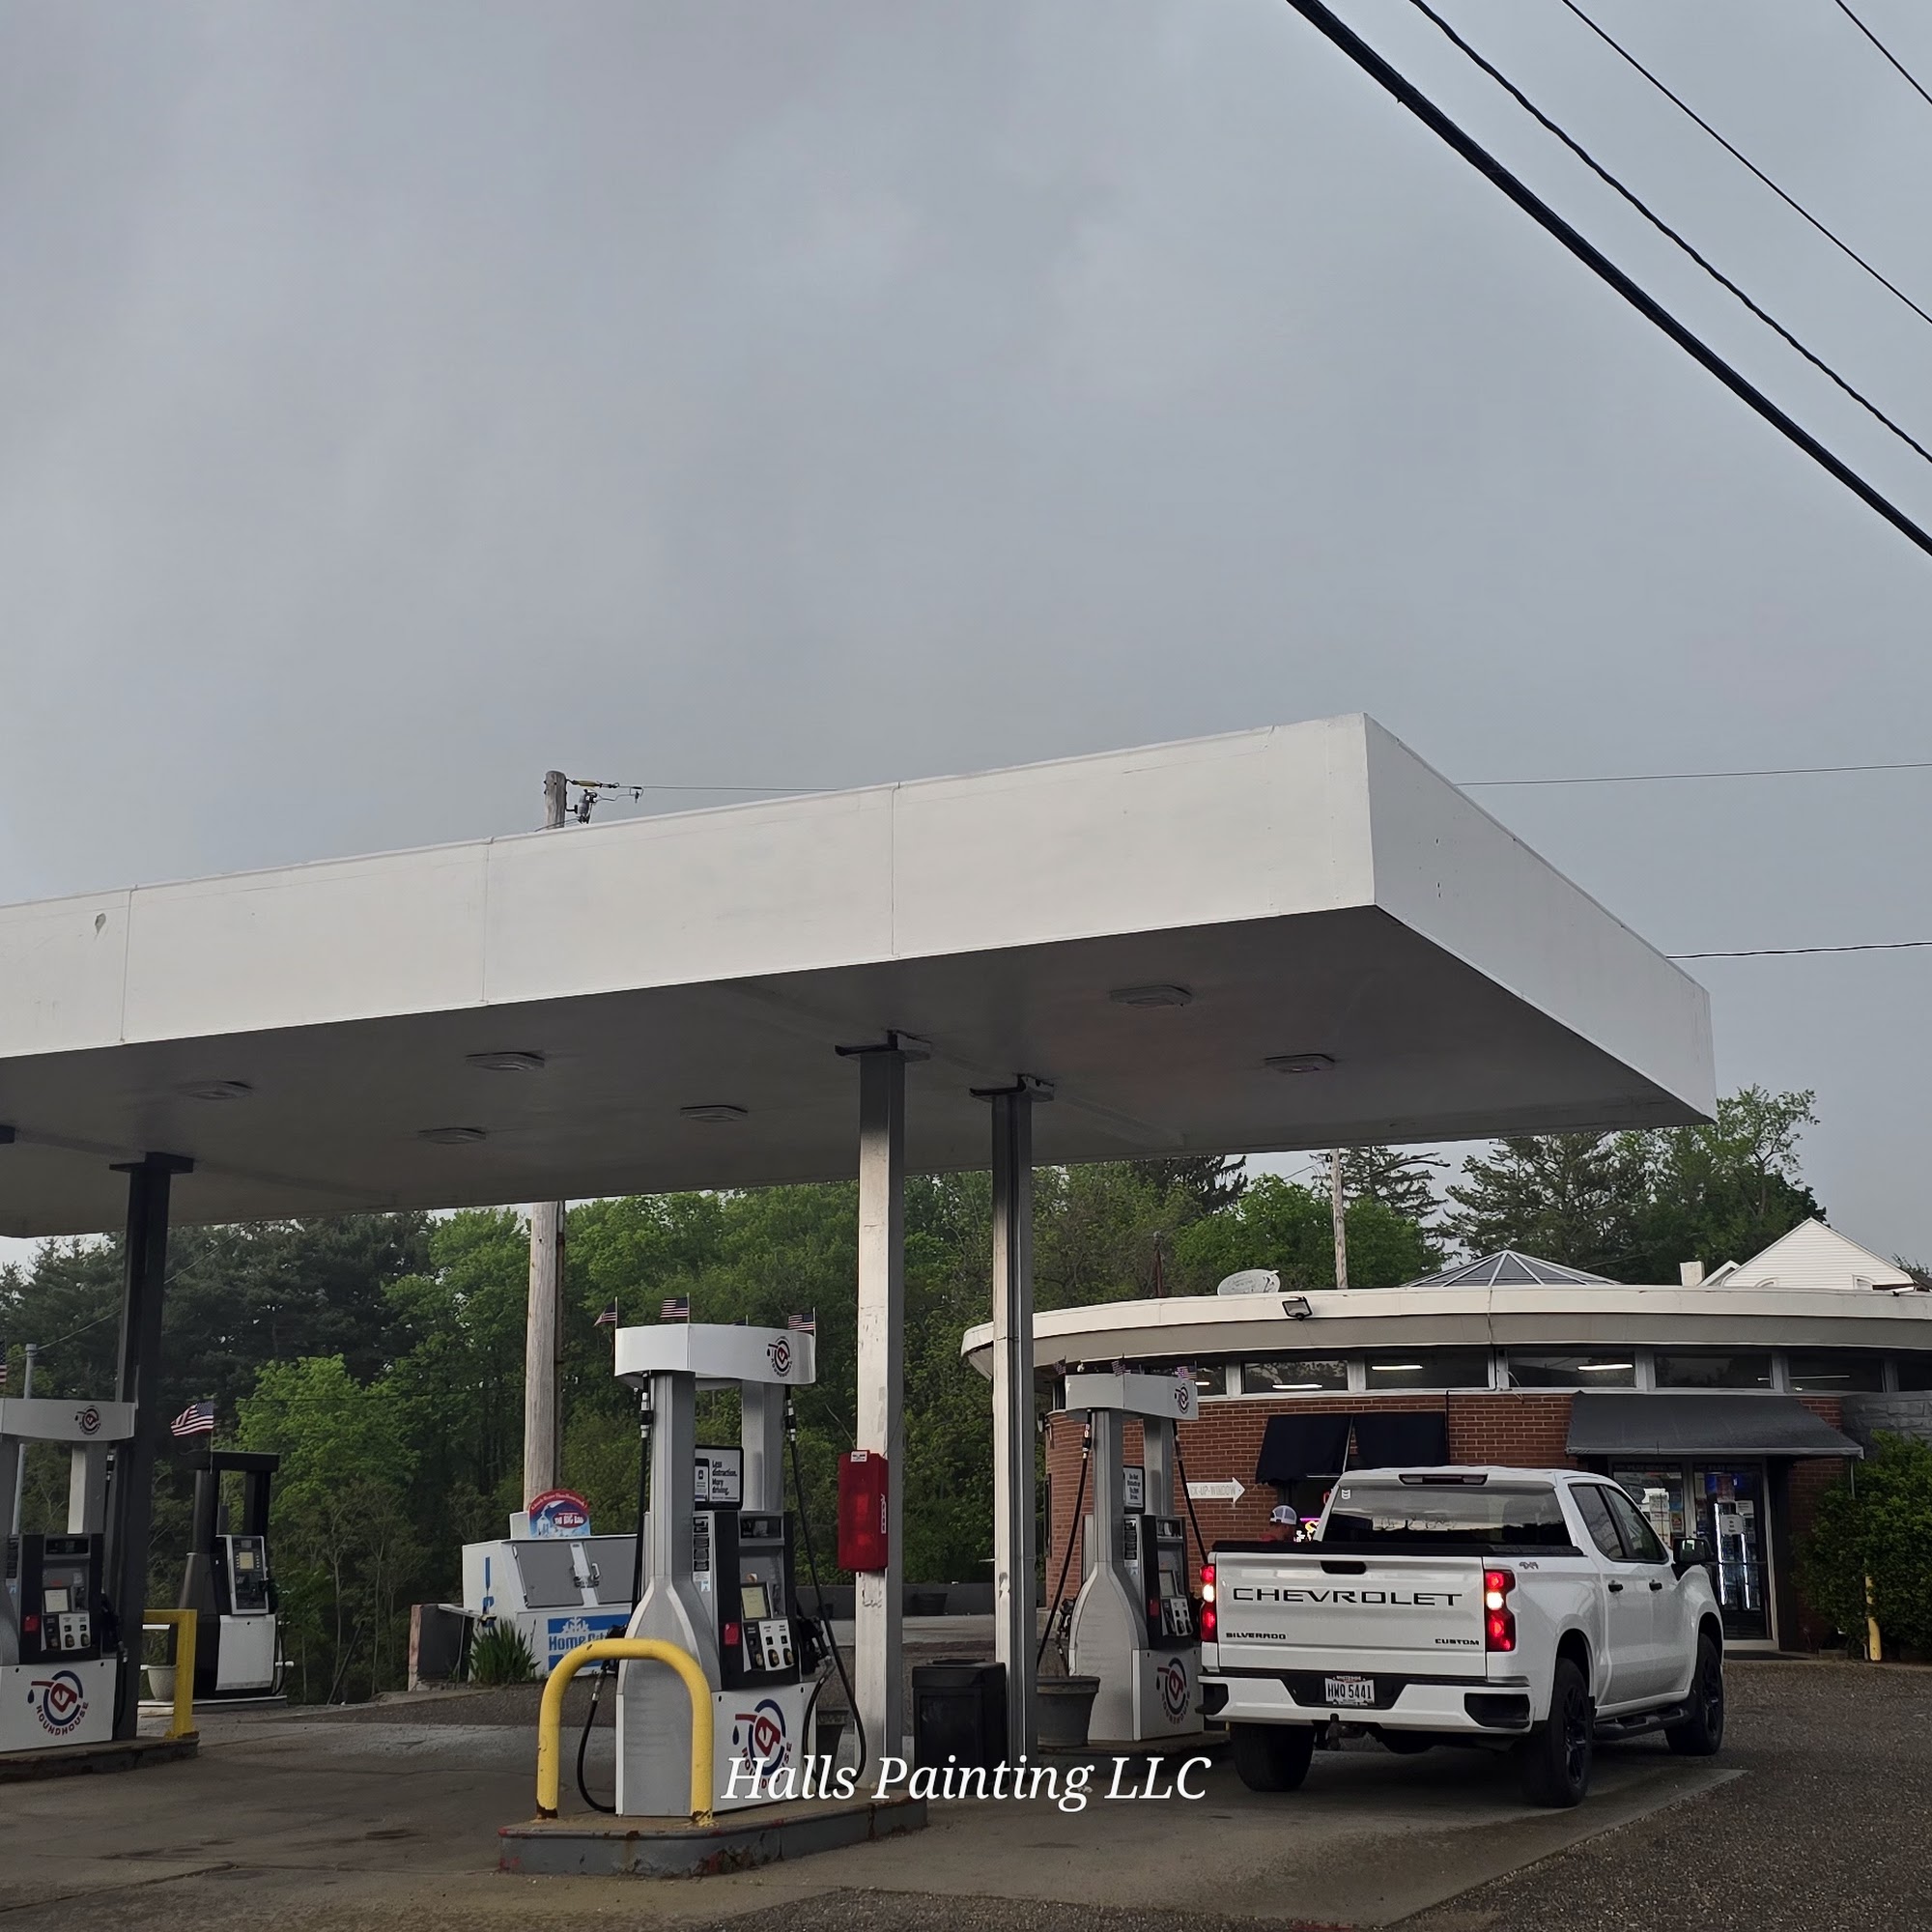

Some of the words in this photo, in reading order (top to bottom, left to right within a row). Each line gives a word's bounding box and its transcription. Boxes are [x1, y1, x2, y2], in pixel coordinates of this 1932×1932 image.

[1233, 1587, 1463, 1606] CHEVROLET
[549, 1634, 585, 1651] Home
[1226, 1632, 1287, 1640] SILVERADO
[1349, 1684, 1372, 1700] 5441
[36, 1701, 89, 1736] ROUNDHOUSE
